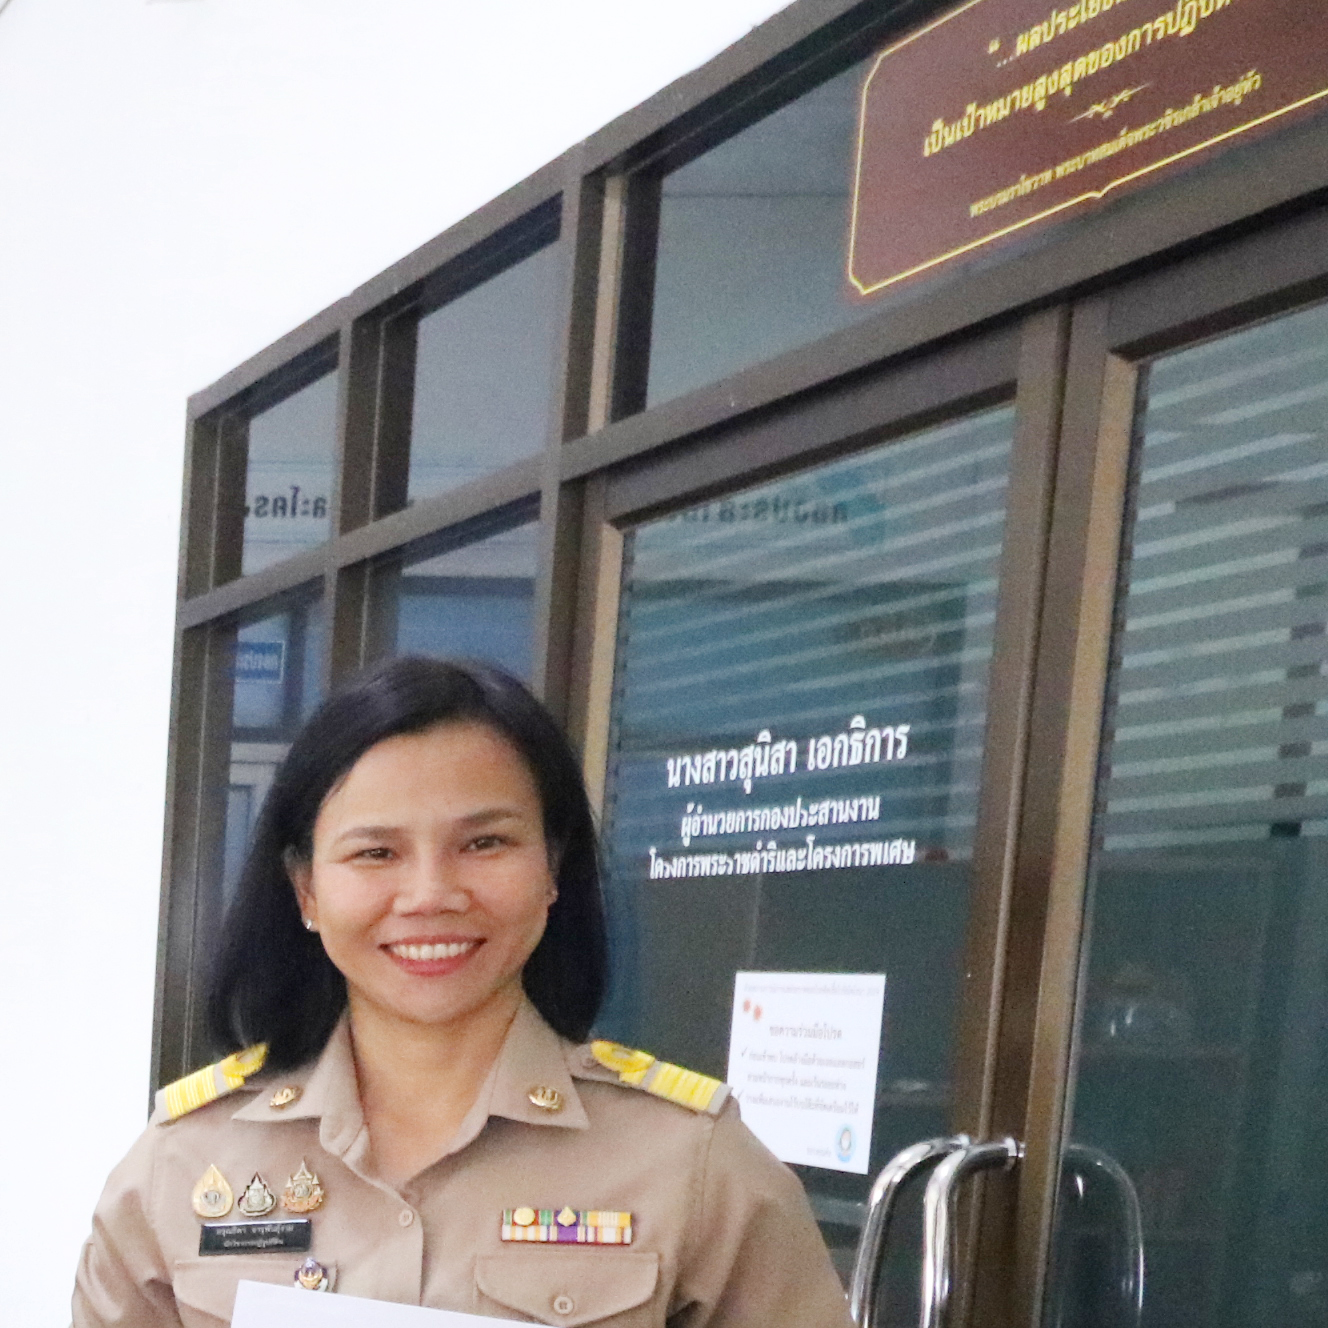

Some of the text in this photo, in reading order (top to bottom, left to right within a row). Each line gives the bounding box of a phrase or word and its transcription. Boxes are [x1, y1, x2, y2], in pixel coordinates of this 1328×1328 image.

[667, 715, 911, 794] นางสาวสุนิสา เอกธิการ
